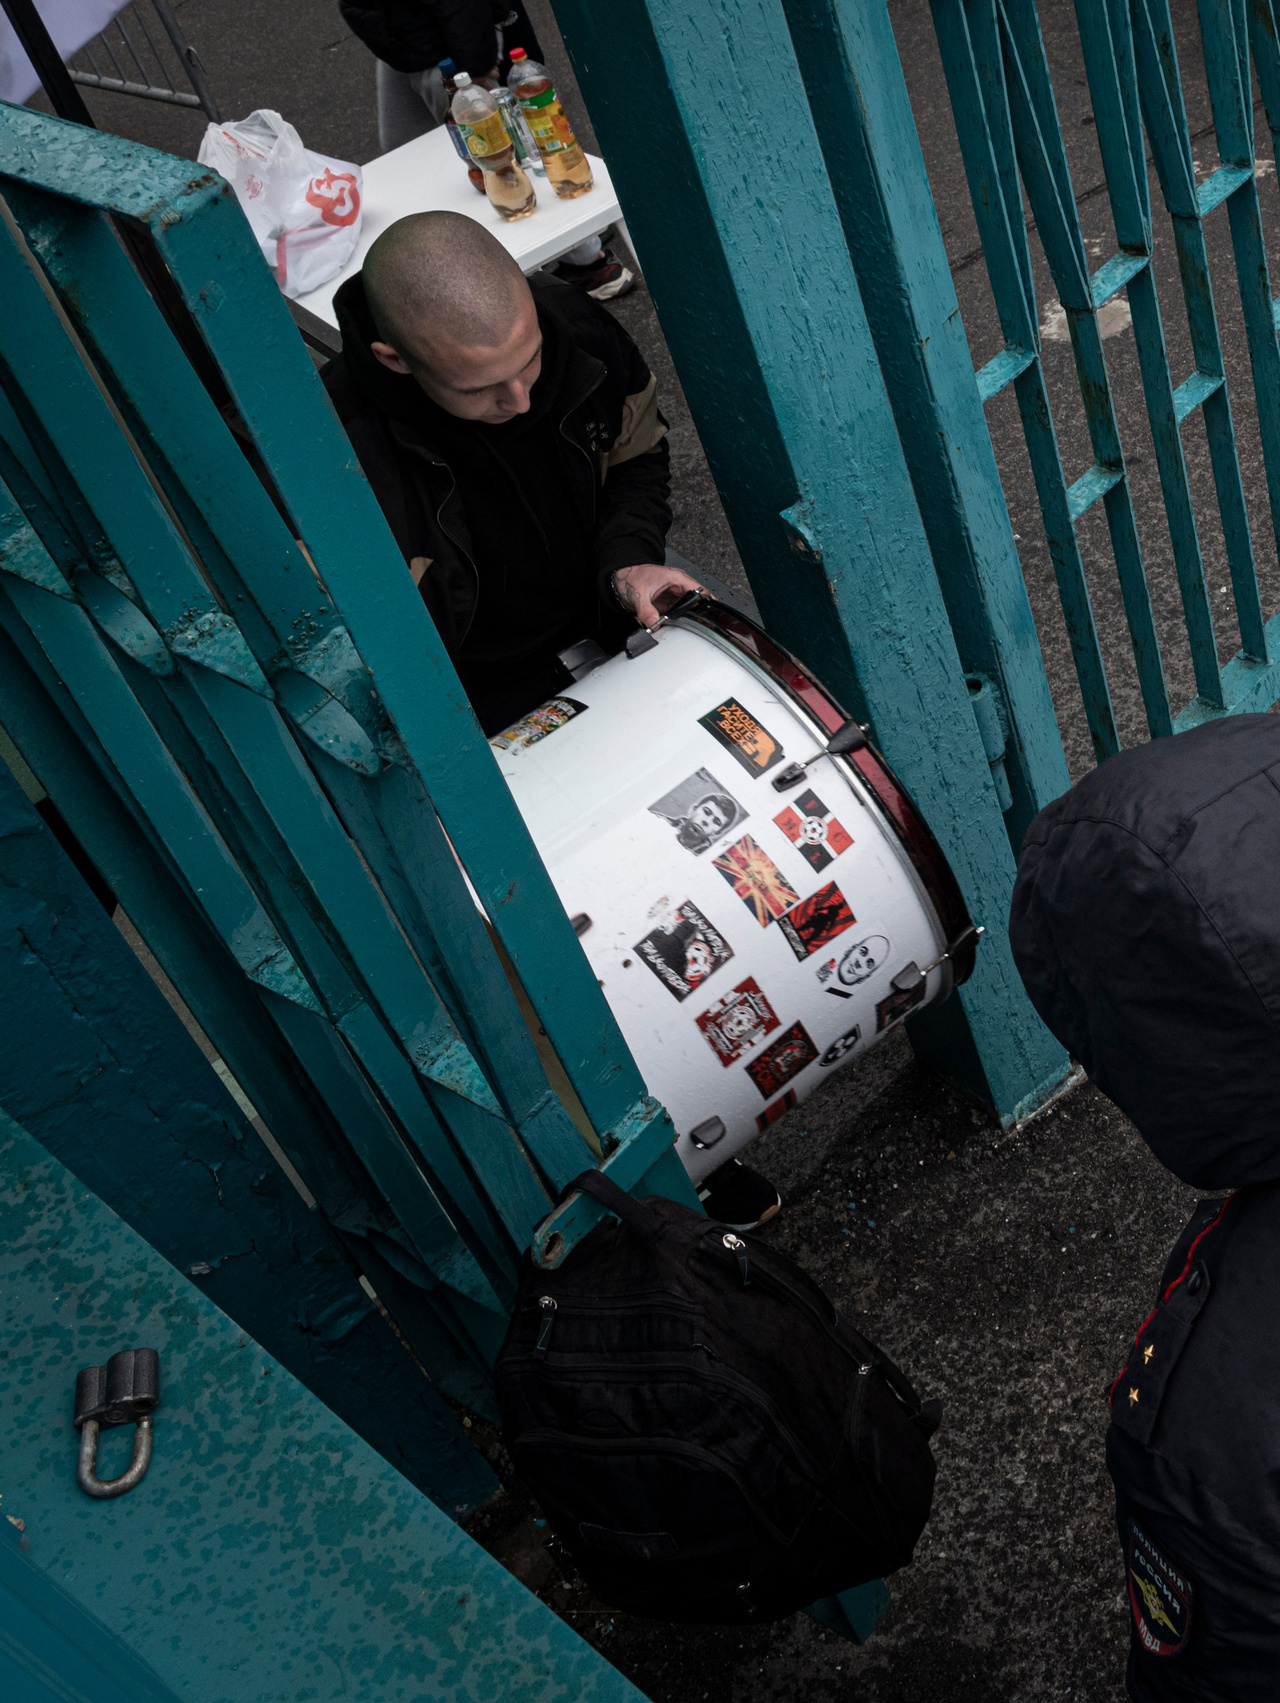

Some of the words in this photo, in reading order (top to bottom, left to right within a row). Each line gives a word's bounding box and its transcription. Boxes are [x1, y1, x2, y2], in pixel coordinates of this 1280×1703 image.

[716, 705, 755, 741] ГАСИТЕ
[717, 719, 748, 747] ВСЕХ
[728, 702, 762, 735] УХОДЯ
[1133, 1525, 1185, 1593] ПОЛИЦИЯ
[1134, 1548, 1181, 1616] РОССИЯ
[1139, 1617, 1161, 1652] МВД
